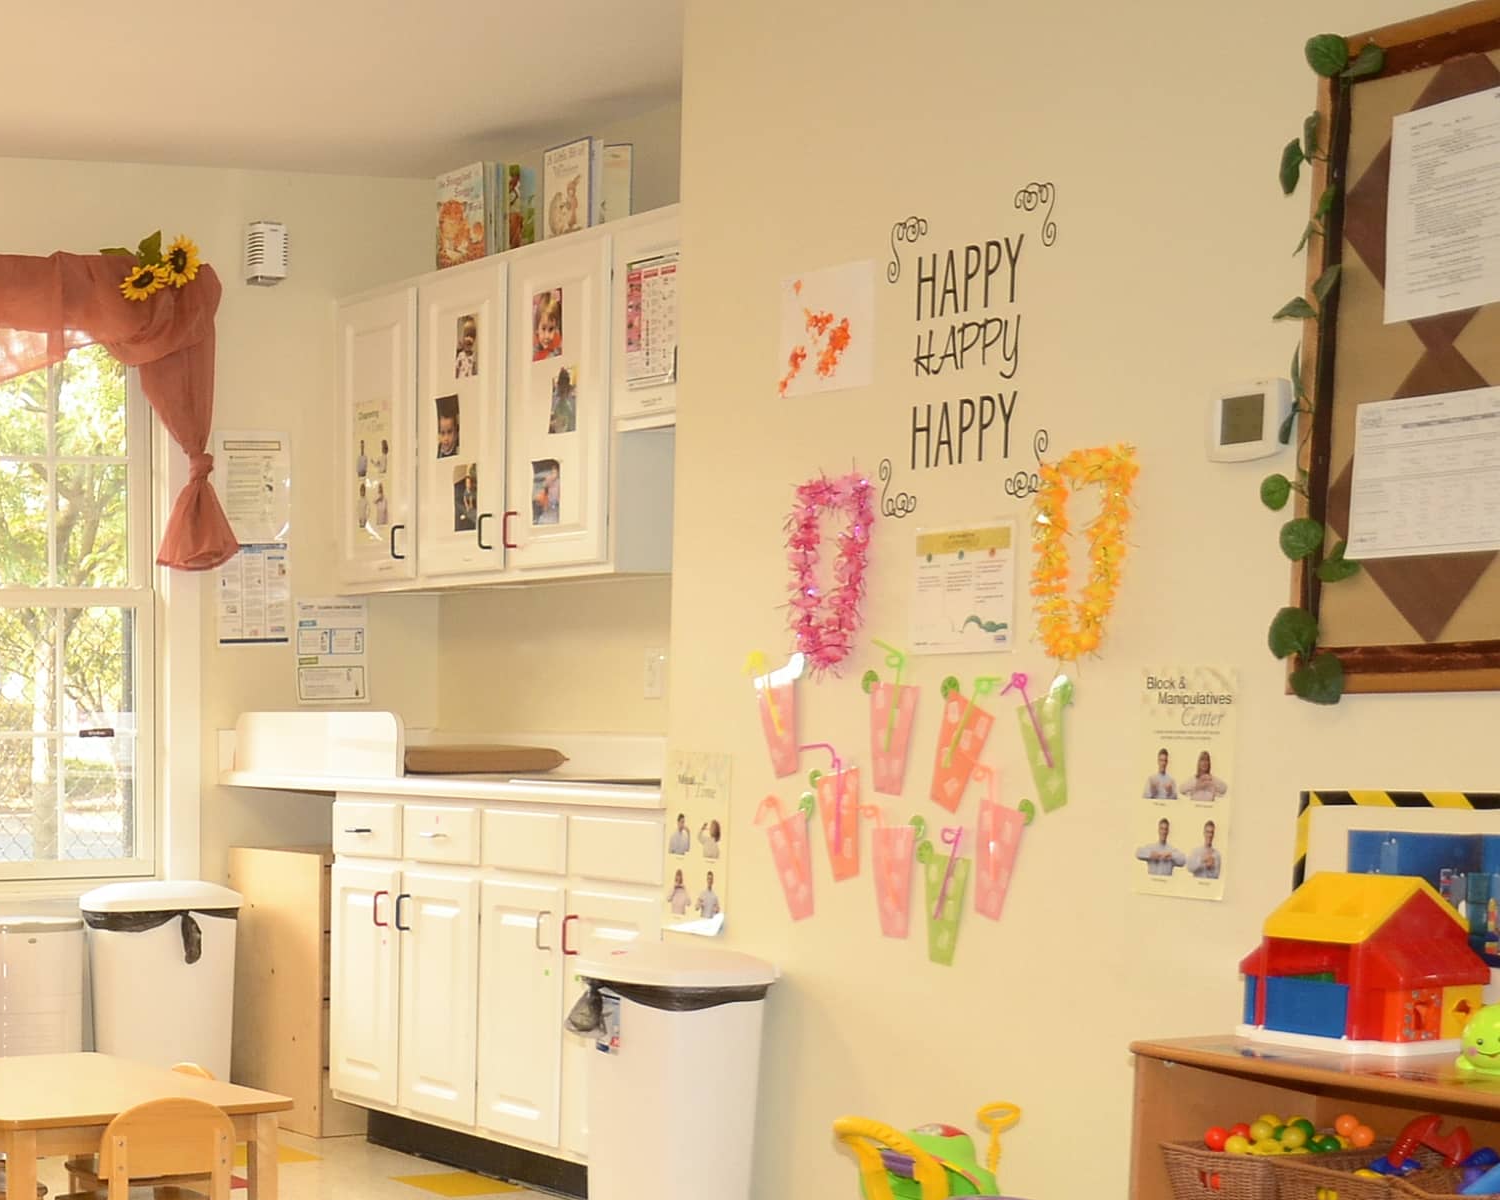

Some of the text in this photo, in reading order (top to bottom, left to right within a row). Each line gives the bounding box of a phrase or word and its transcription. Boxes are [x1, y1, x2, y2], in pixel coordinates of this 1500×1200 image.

[916, 234, 1024, 321] HAPPY
[914, 314, 1021, 379] HAPPY
[911, 390, 1018, 470] HAPPY
[1147, 677, 1186, 689] Block &
[1158, 692, 1232, 706] Manipulatives
[1181, 706, 1226, 728] Center
